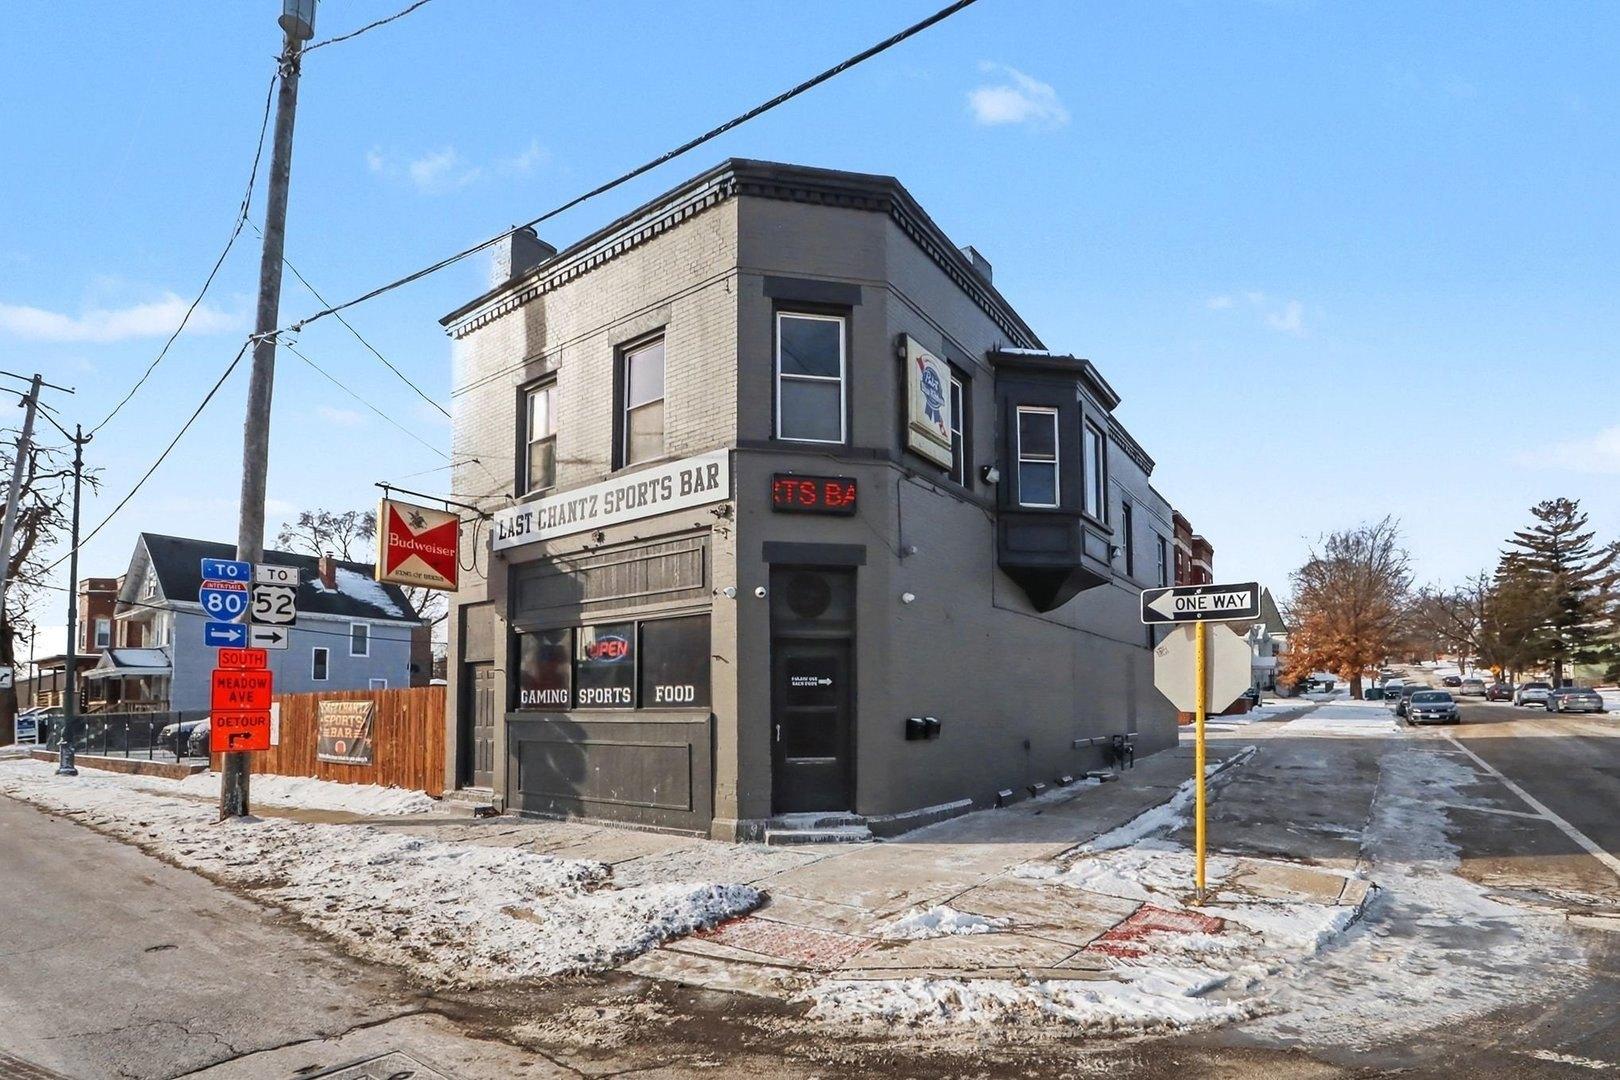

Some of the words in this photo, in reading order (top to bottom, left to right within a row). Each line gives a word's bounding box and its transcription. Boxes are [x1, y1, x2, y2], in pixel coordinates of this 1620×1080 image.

[498, 512, 533, 541] LAST
[537, 494, 599, 531] CHANTZ
[603, 475, 673, 515] SPORTS
[679, 462, 720, 497] BAR
[389, 531, 456, 557] Budweiser
[214, 563, 238, 577] TO
[267, 568, 288, 581] TO
[207, 592, 242, 614] 80
[256, 592, 293, 616] 52
[1175, 596, 1207, 611] ONE
[1213, 593, 1247, 609] WAY
[588, 639, 629, 657] OPEN
[222, 652, 263, 666] SOUTH
[217, 678, 267, 690] MEADOW
[228, 691, 255, 703] AVE
[520, 689, 568, 704] GAMING
[578, 687, 631, 704] SPORTS
[655, 684, 695, 702] FOOD
[217, 716, 266, 728] DETOUR
[323, 714, 363, 727] SPORTS
[330, 727, 352, 738] BAR
